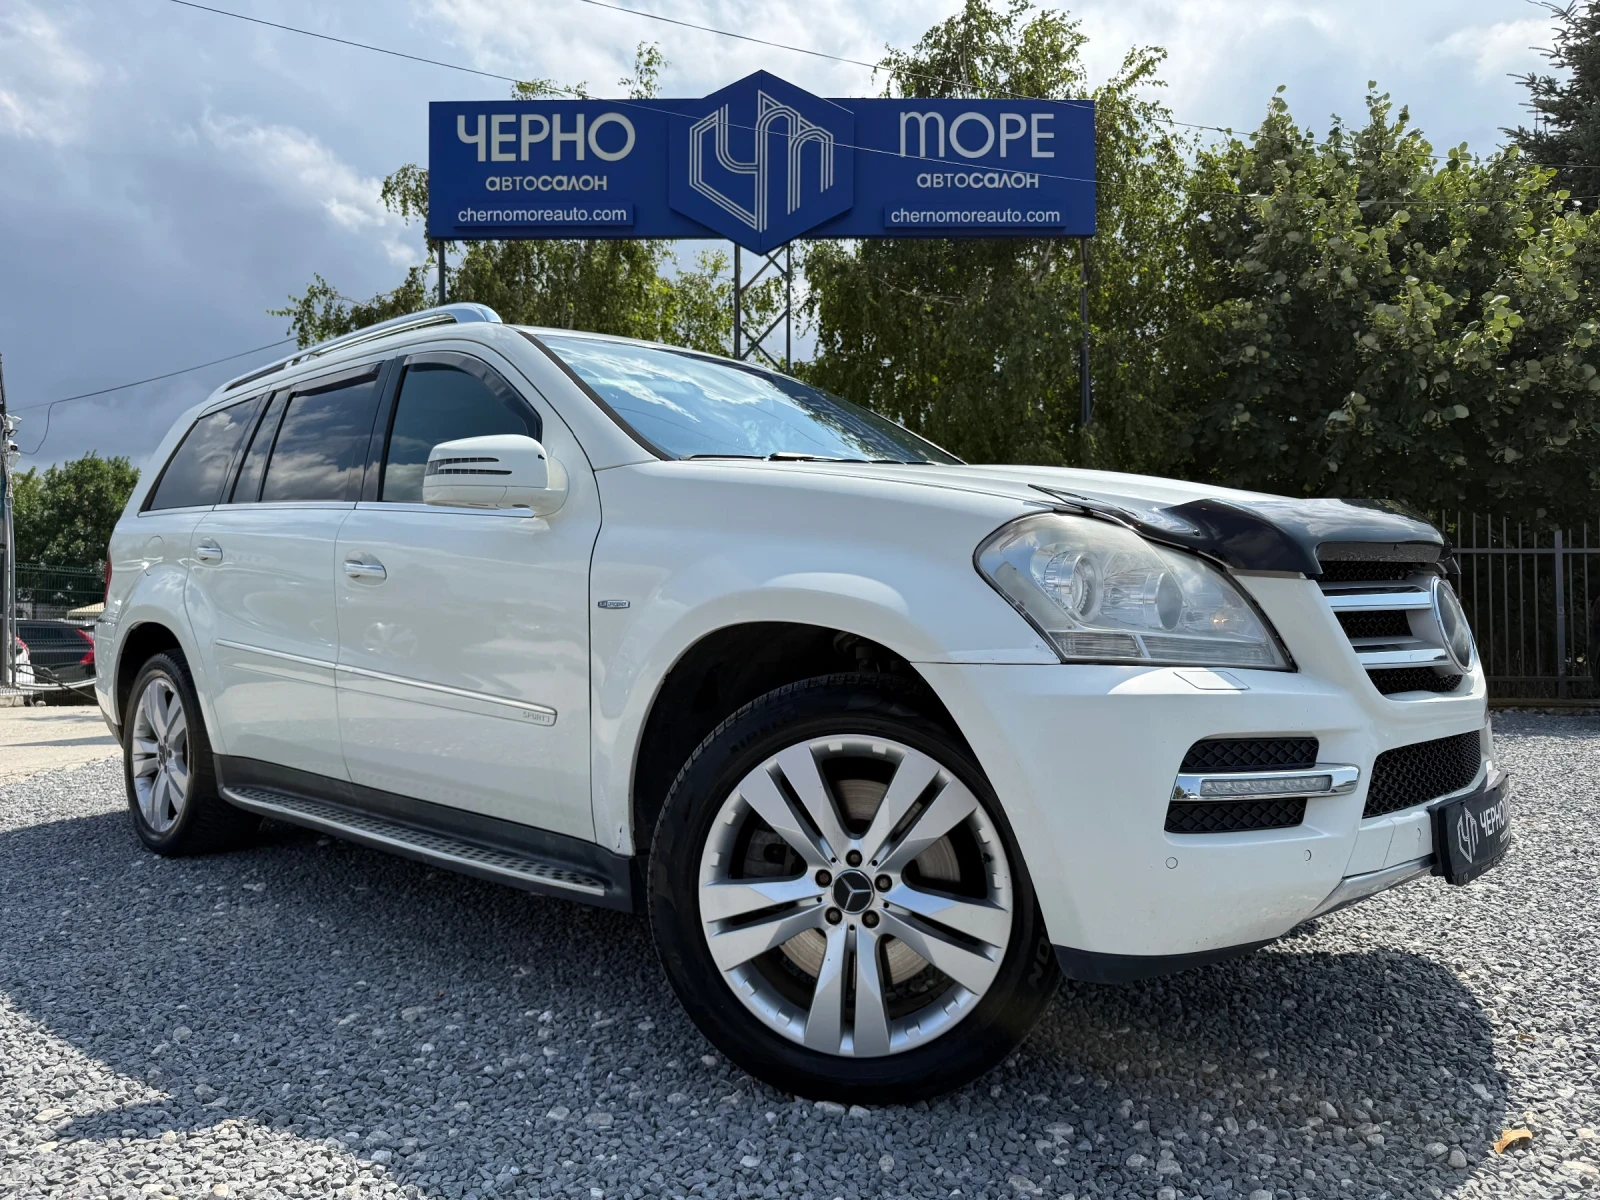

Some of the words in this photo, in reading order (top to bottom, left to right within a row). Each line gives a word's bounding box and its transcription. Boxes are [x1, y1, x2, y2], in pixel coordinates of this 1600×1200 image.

[457, 112, 636, 162] ЧЕРНО
[900, 111, 1055, 159] МОРЕ
[457, 207, 627, 222] chernomoreauto.com
[891, 208, 1060, 223] chernomoreauto.com
[1480, 800, 1505, 837] ЧЕРНО
